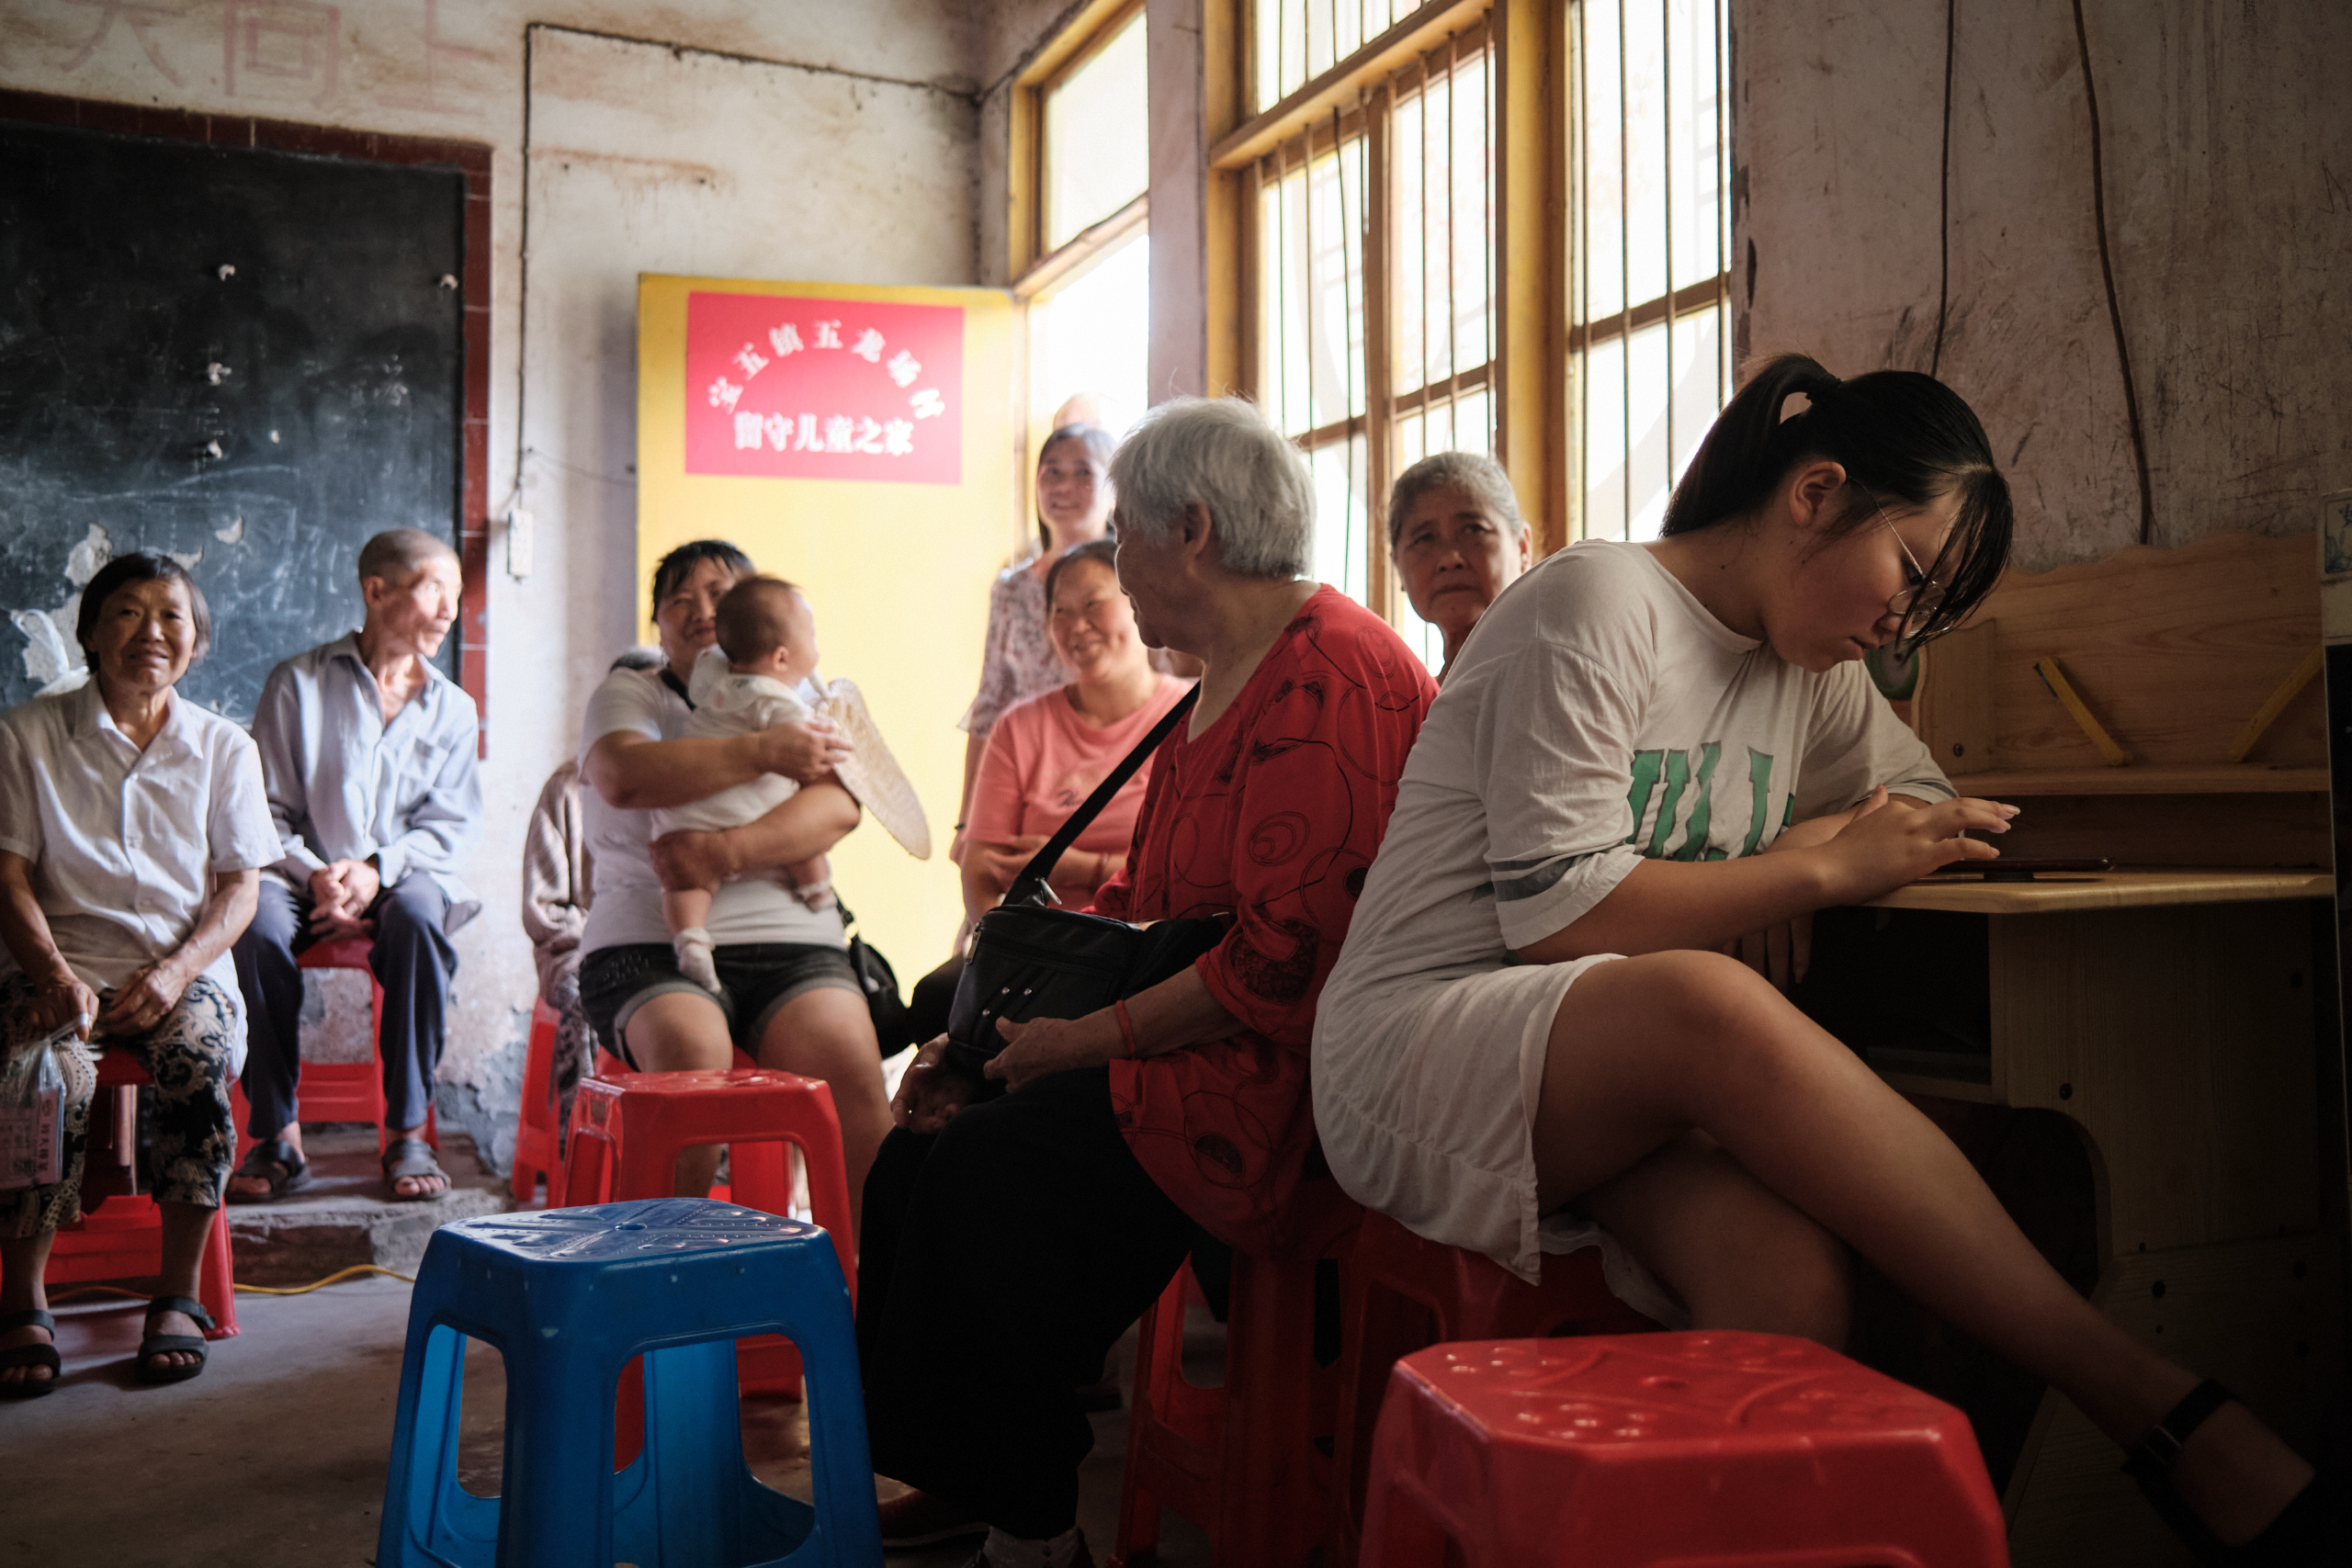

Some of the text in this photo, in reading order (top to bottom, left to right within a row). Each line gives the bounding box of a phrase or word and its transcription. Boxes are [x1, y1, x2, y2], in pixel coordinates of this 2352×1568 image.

[734, 411, 914, 457] 留守儿童之家
